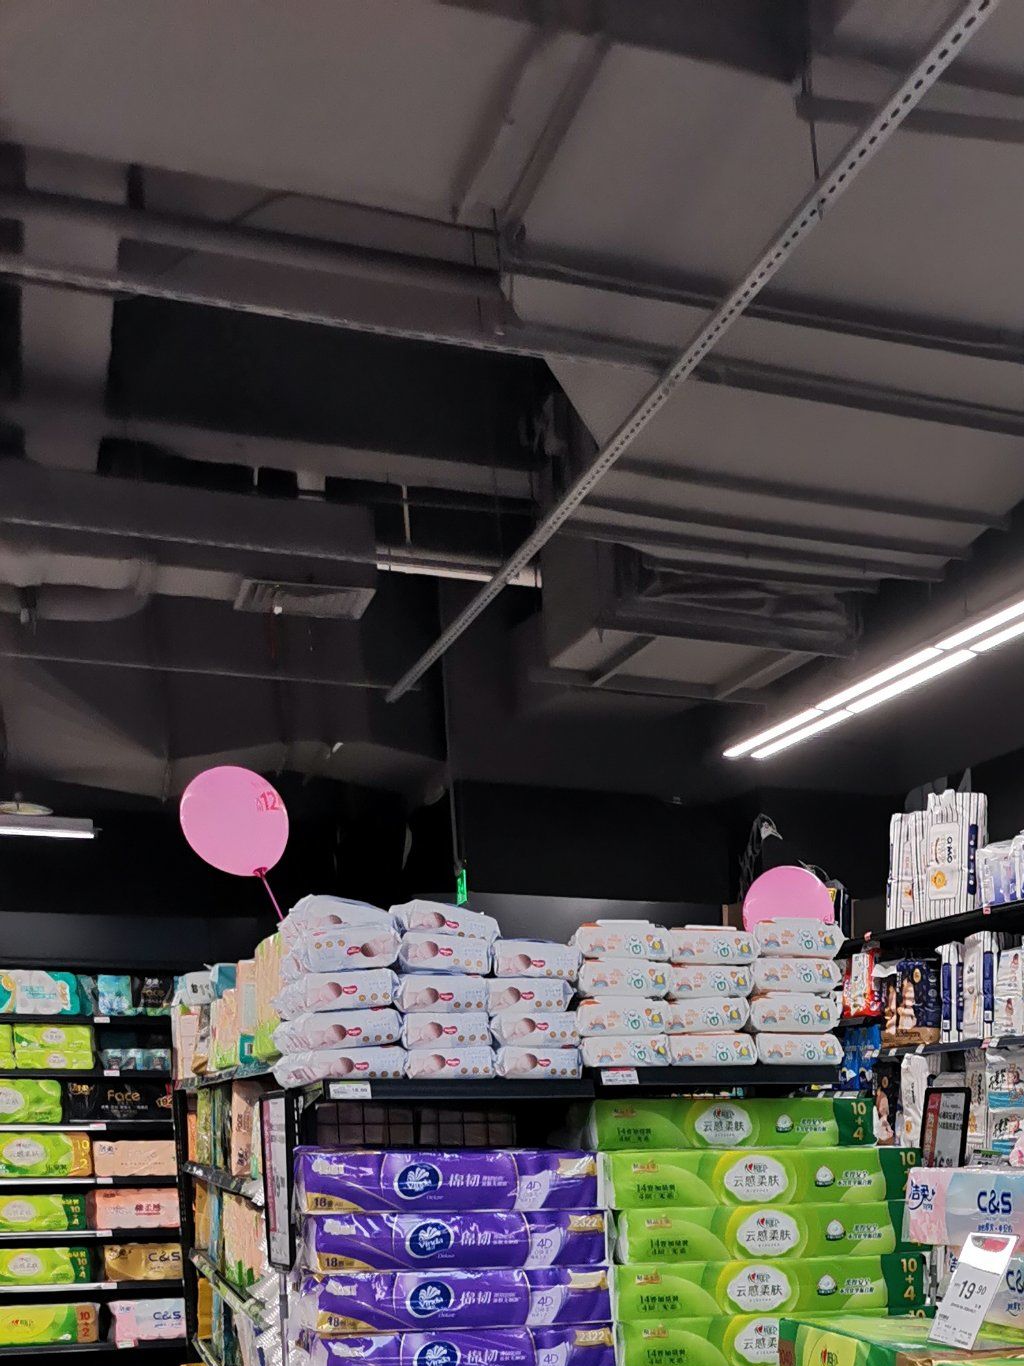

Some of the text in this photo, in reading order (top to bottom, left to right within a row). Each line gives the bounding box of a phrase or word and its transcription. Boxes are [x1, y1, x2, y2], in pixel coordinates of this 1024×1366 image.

[260, 791, 280, 811] 12
[107, 1089, 141, 1102] Face
[851, 1102, 867, 1115] 10
[703, 1119, 744, 1133] 云感柔肤
[853, 1128, 864, 1141] 4
[900, 1151, 916, 1166] 10
[733, 1175, 780, 1189] 云感柔肤
[977, 1190, 1012, 1215] C&S
[418, 1237, 443, 1249] Vinda
[746, 1229, 791, 1243] 云感柔肤
[148, 1251, 181, 1263] C&S
[901, 1257, 918, 1301] 10 4
[736, 1284, 782, 1298] 云感柔肤
[959, 1280, 987, 1300] 19.90
[153, 1310, 182, 1321] C&S
[743, 1338, 778, 1352] 云感柔
